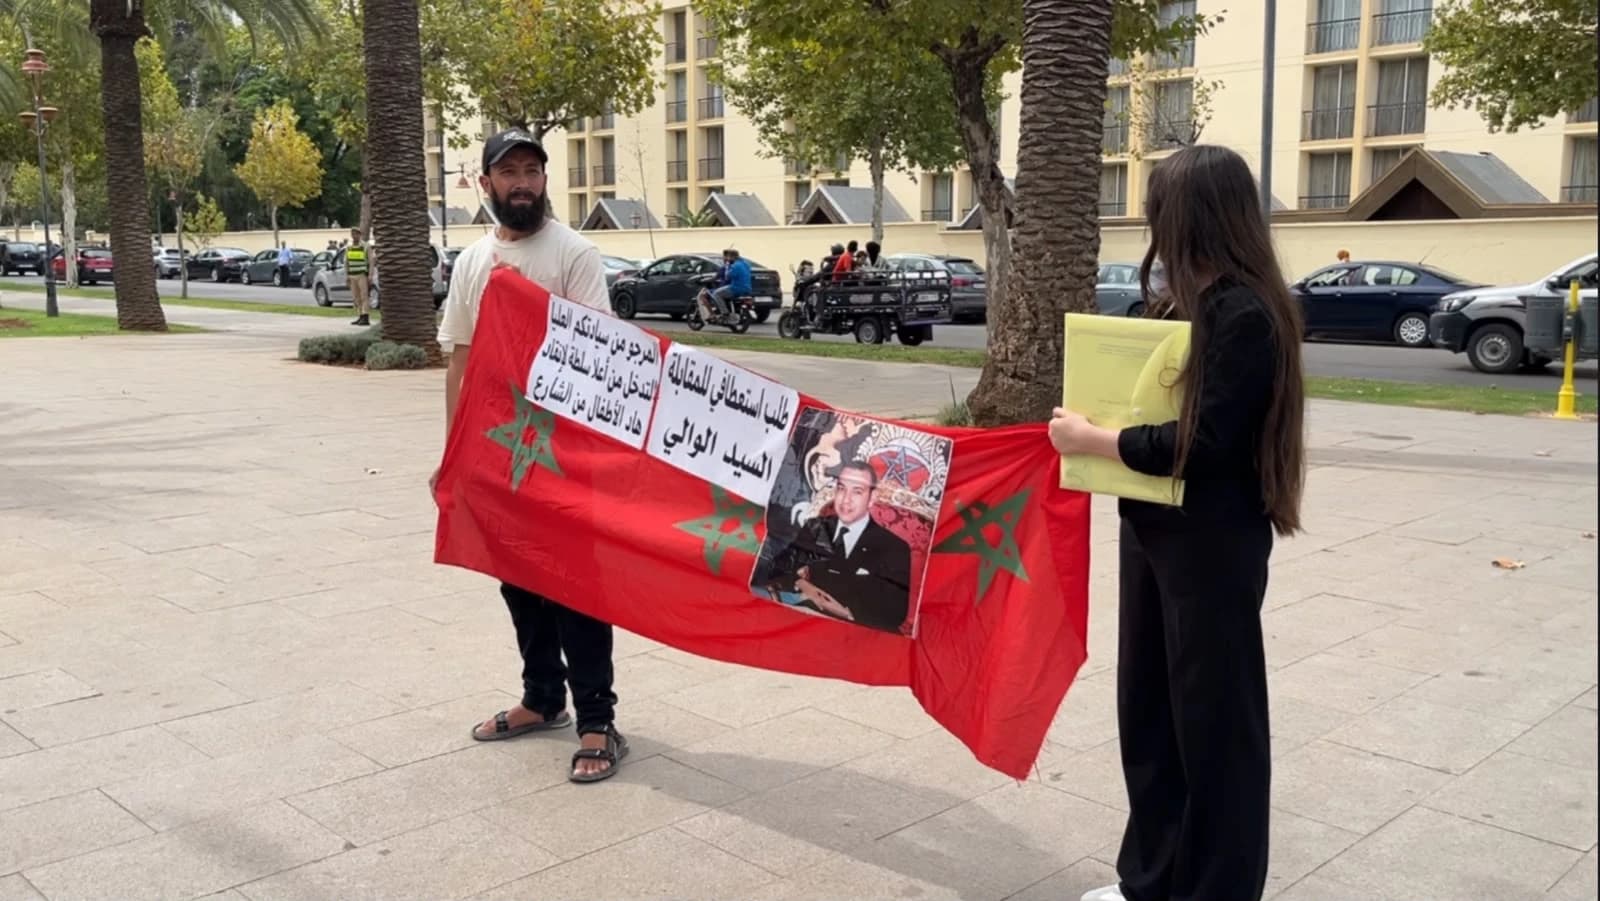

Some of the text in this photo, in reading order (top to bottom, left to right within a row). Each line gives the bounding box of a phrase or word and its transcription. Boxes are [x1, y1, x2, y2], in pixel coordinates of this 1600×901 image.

[551, 302, 659, 365] المرجو من سيادتكم العليا
[568, 346, 590, 375] سلطة
[533, 375, 642, 435] هاد الأطفال من الشارع
[607, 370, 622, 392] من
[668, 352, 789, 433] طلب استعطافي للمقابلة
[663, 416, 772, 480] السيد الوالي
